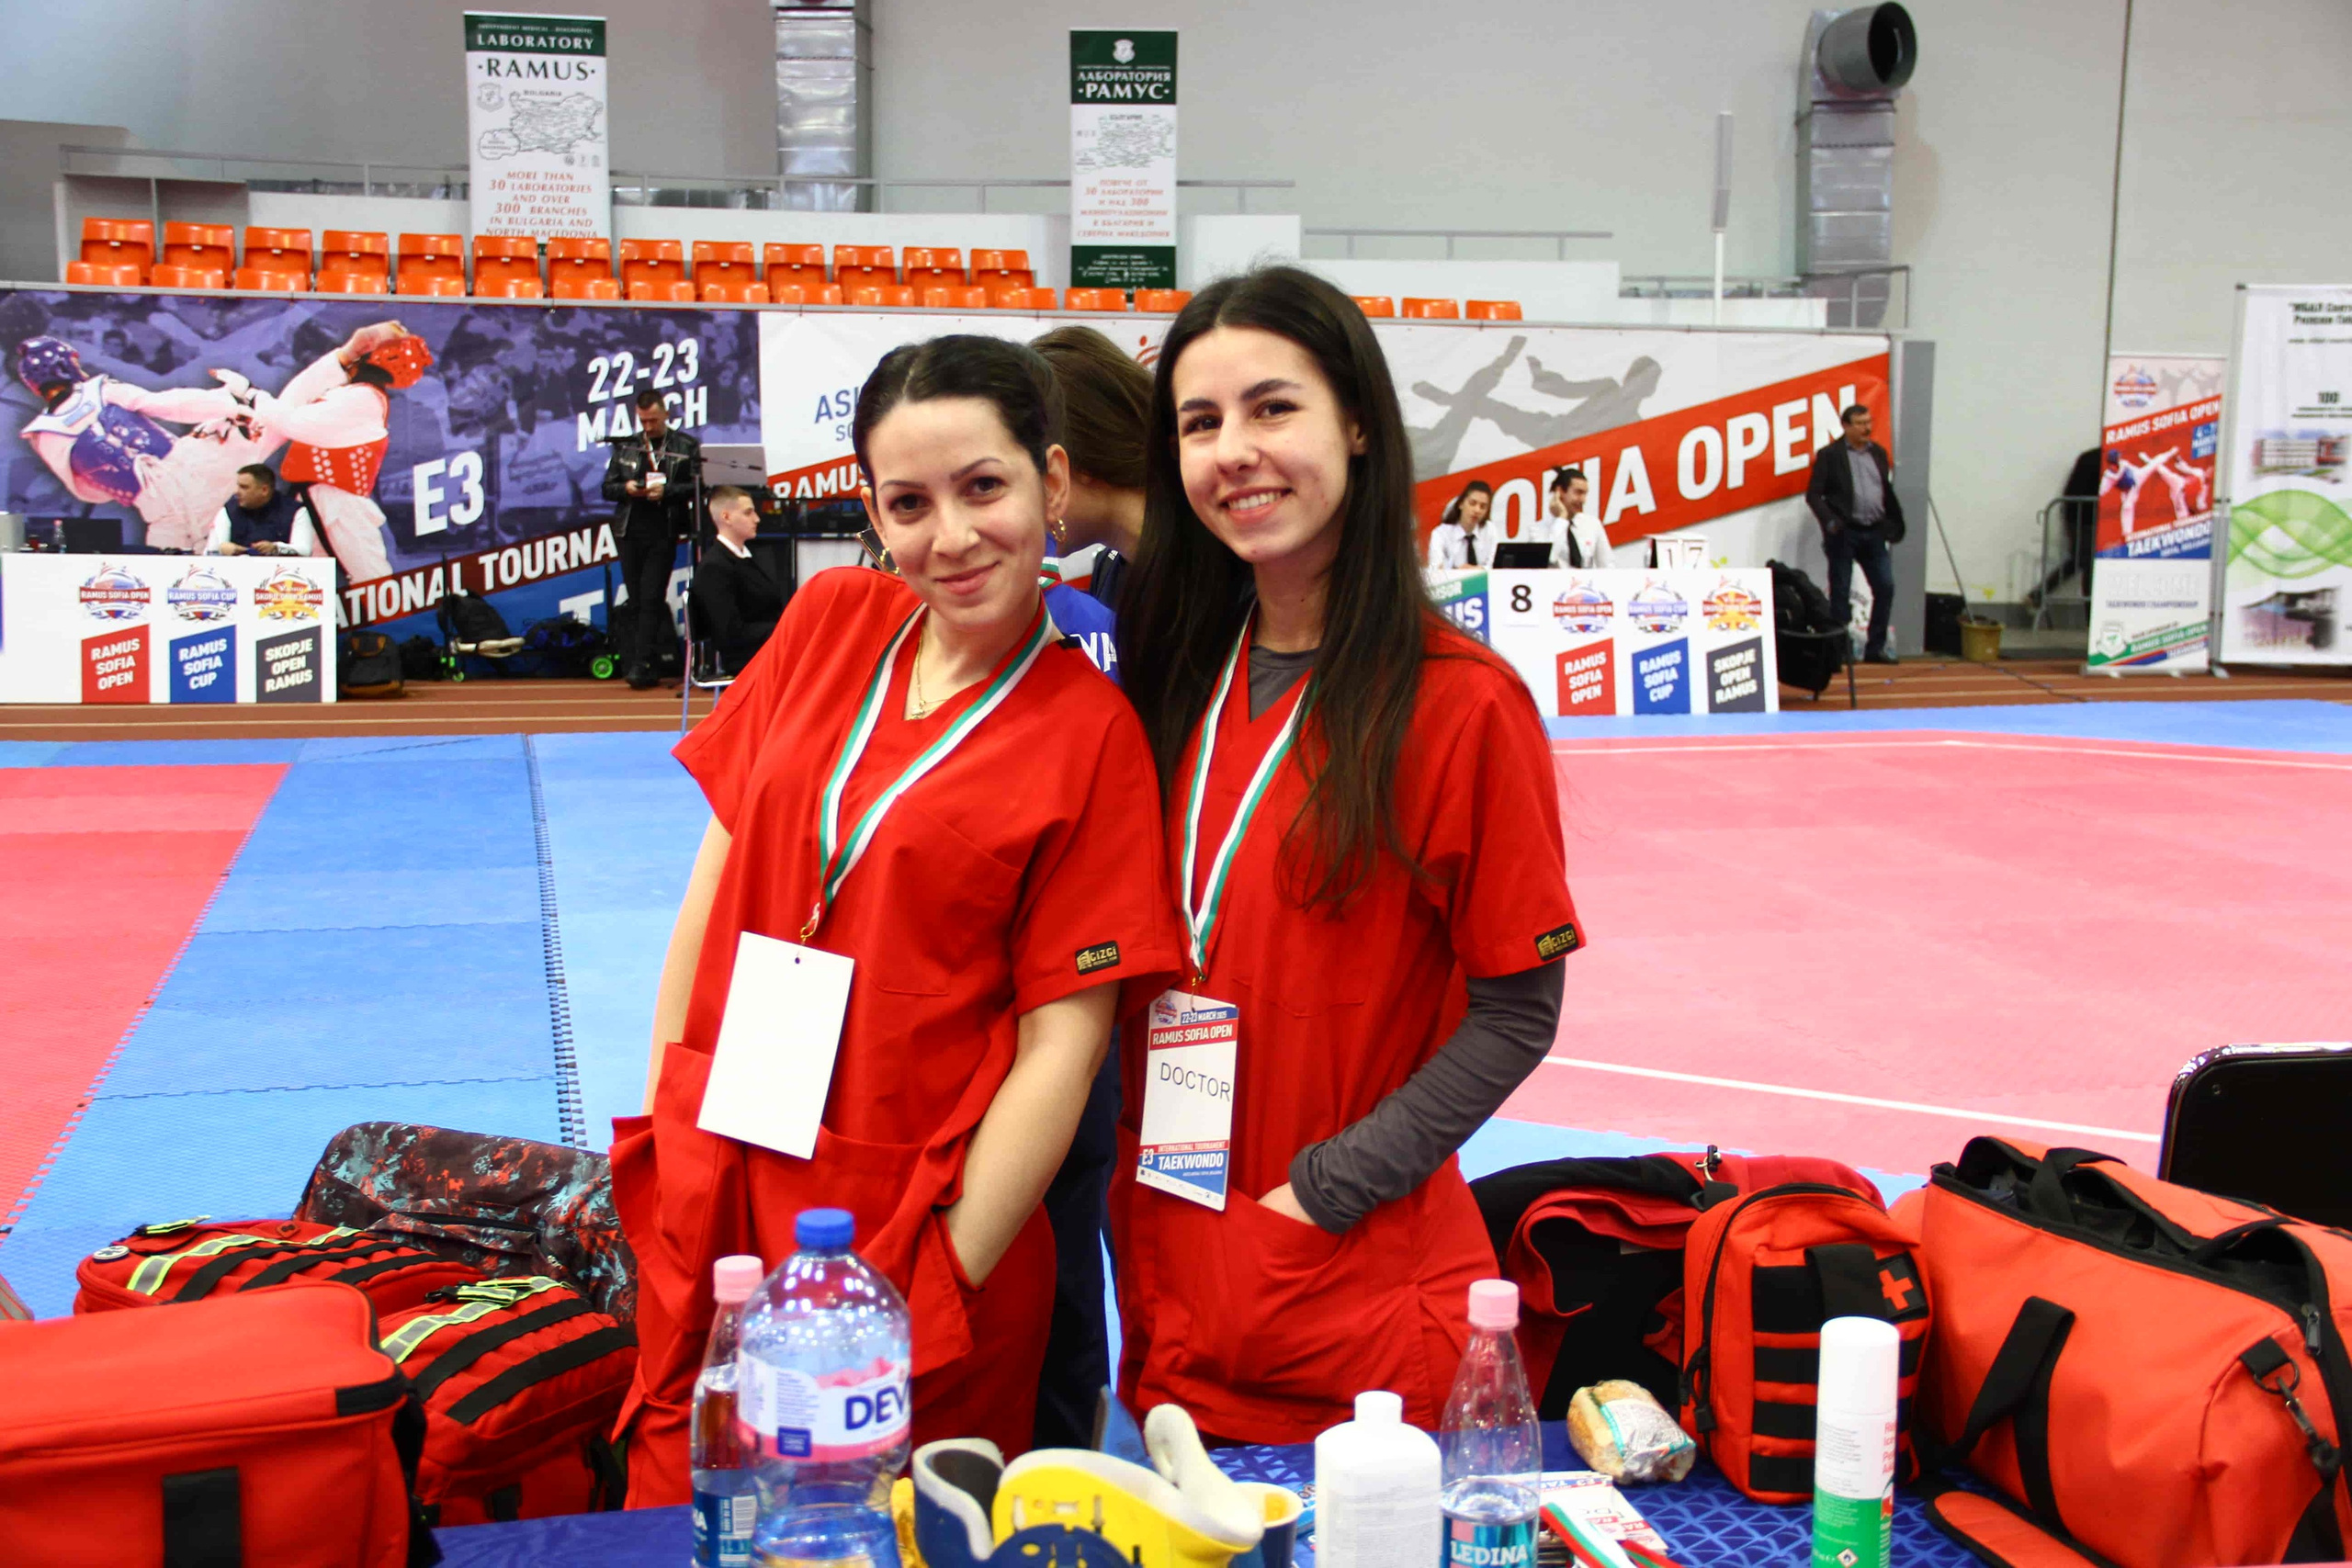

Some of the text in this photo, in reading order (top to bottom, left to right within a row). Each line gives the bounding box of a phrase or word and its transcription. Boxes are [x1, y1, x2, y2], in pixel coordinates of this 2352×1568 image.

[477, 33, 594, 50] LABORATORY
[487, 58, 589, 81] RAMUS
[1077, 71, 1171, 82] ЛАБОРАТОРИЯ
[1085, 82, 1164, 100] РАМУС
[489, 179, 593, 193] 30 LABORATORIES
[507, 171, 574, 181] MORE THAN
[495, 202, 588, 216] 300 BRANCHES
[513, 194, 571, 204] AND OVER
[490, 216, 594, 228] IN BULGARIA AND
[485, 228, 598, 239] NORTH MACEDONIA
[587, 337, 699, 404] 22-23
[577, 386, 707, 453] MACH
[2105, 419, 2151, 446] RAMUS
[2151, 409, 2188, 432] SOFIA
[1676, 383, 1857, 501] OPEN
[413, 450, 485, 538] E3
[2127, 522, 2212, 558] TAEKWONDO
[82, 591, 150, 600] RAMUS SOFIA OPEN
[168, 592, 237, 601] RAMUS SOFIA CUP
[1510, 584, 1532, 613] 8
[92, 637, 141, 661] RAMUS
[178, 638, 227, 661] RAMUS
[265, 637, 313, 662] SKOPJE
[96, 656, 136, 676] SOFIA
[183, 656, 223, 676] SOFIA
[271, 656, 306, 675] OPEN
[1565, 651, 1607, 676] RAMUS
[1639, 649, 1682, 675] RAMUS
[1713, 648, 1757, 674] SKOPJE
[97, 671, 134, 691] OPEN
[189, 671, 217, 690] CUP
[265, 669, 313, 694] RAMUS
[1568, 669, 1603, 691] SOFIA
[1643, 667, 1679, 689] SOFIA
[1720, 666, 1751, 687] OPEN
[1570, 684, 1602, 705] OPEN
[1649, 683, 1674, 703] CUP
[1714, 680, 1758, 705] RAMUS
[1182, 1011, 1197, 1024] 22-23
[1198, 1010, 1216, 1021] MARCH
[1152, 1023, 1233, 1045] RAMUS SOFIA OPEN
[1160, 1061, 1231, 1102] DOCTOR
[1142, 1148, 1155, 1166] E3
[1158, 1152, 1225, 1171] TAEKWONDO
[1450, 1540, 1529, 1566] LEDINA
